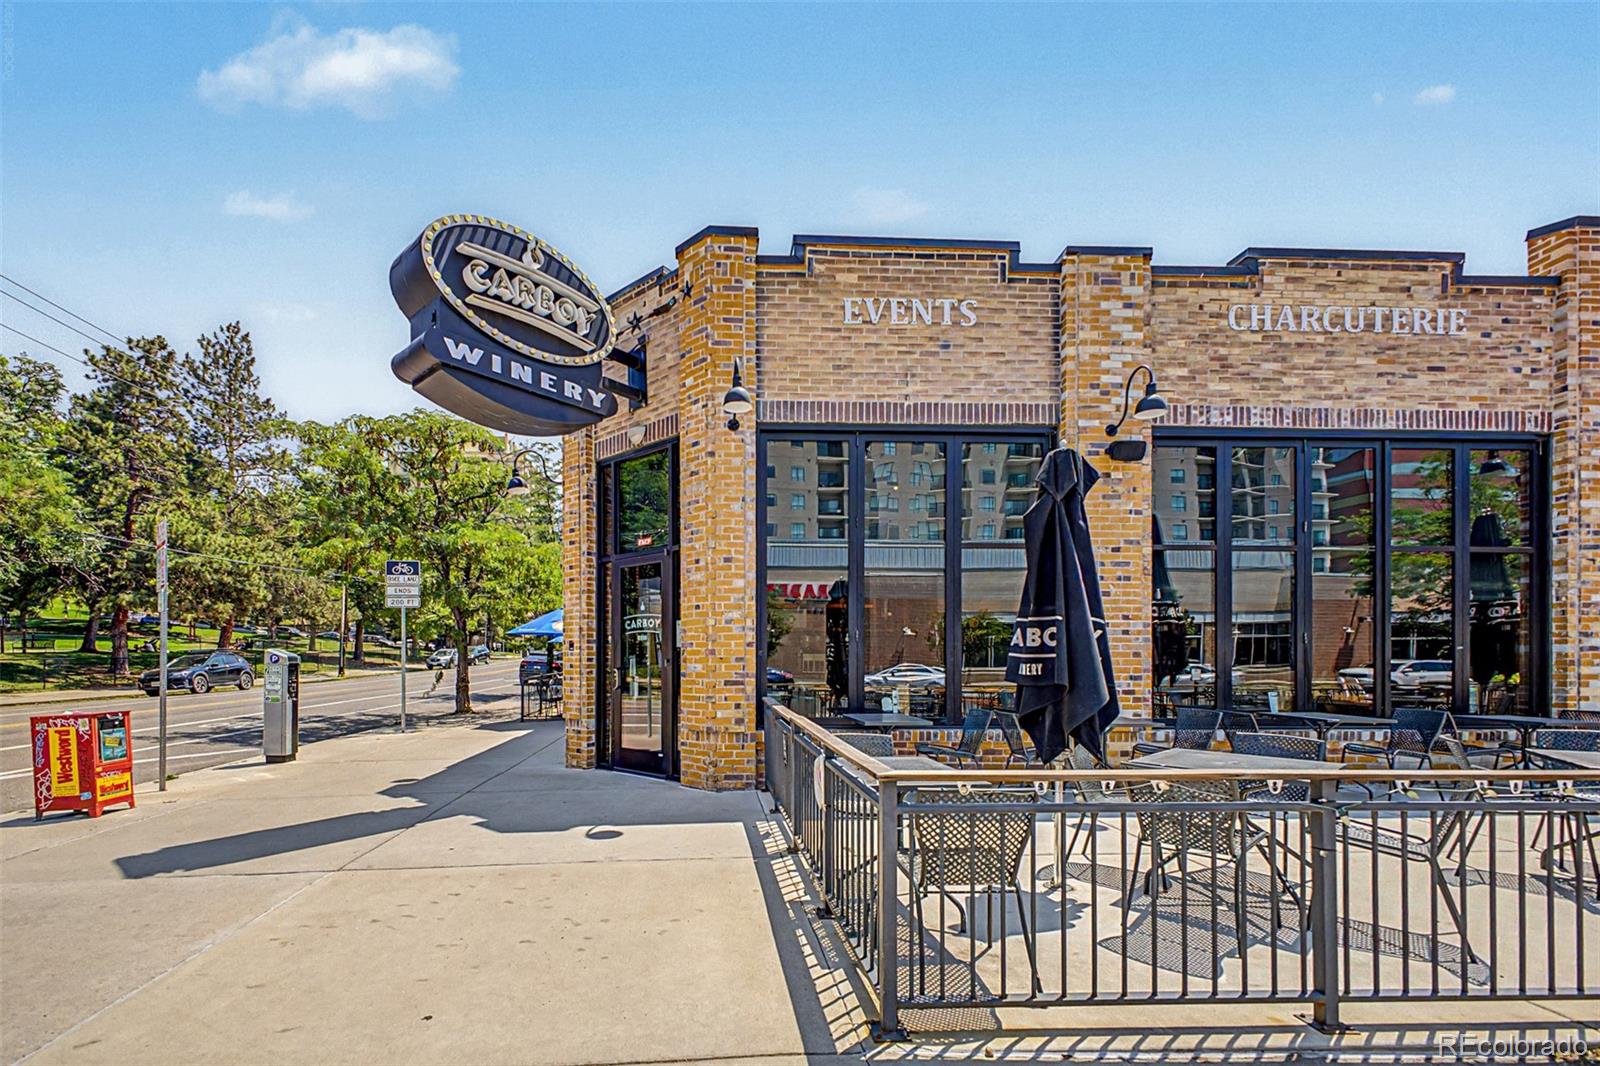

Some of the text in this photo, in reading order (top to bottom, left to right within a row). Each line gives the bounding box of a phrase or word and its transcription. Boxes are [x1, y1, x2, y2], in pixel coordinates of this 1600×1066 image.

[462, 259, 598, 337] CARBOY
[843, 297, 978, 327] EVENTS
[1228, 304, 1468, 336] CHARCUTERIE
[443, 336, 606, 408] WINERY
[624, 618, 661, 631] CARBOY
[54, 729, 74, 785] Westword
